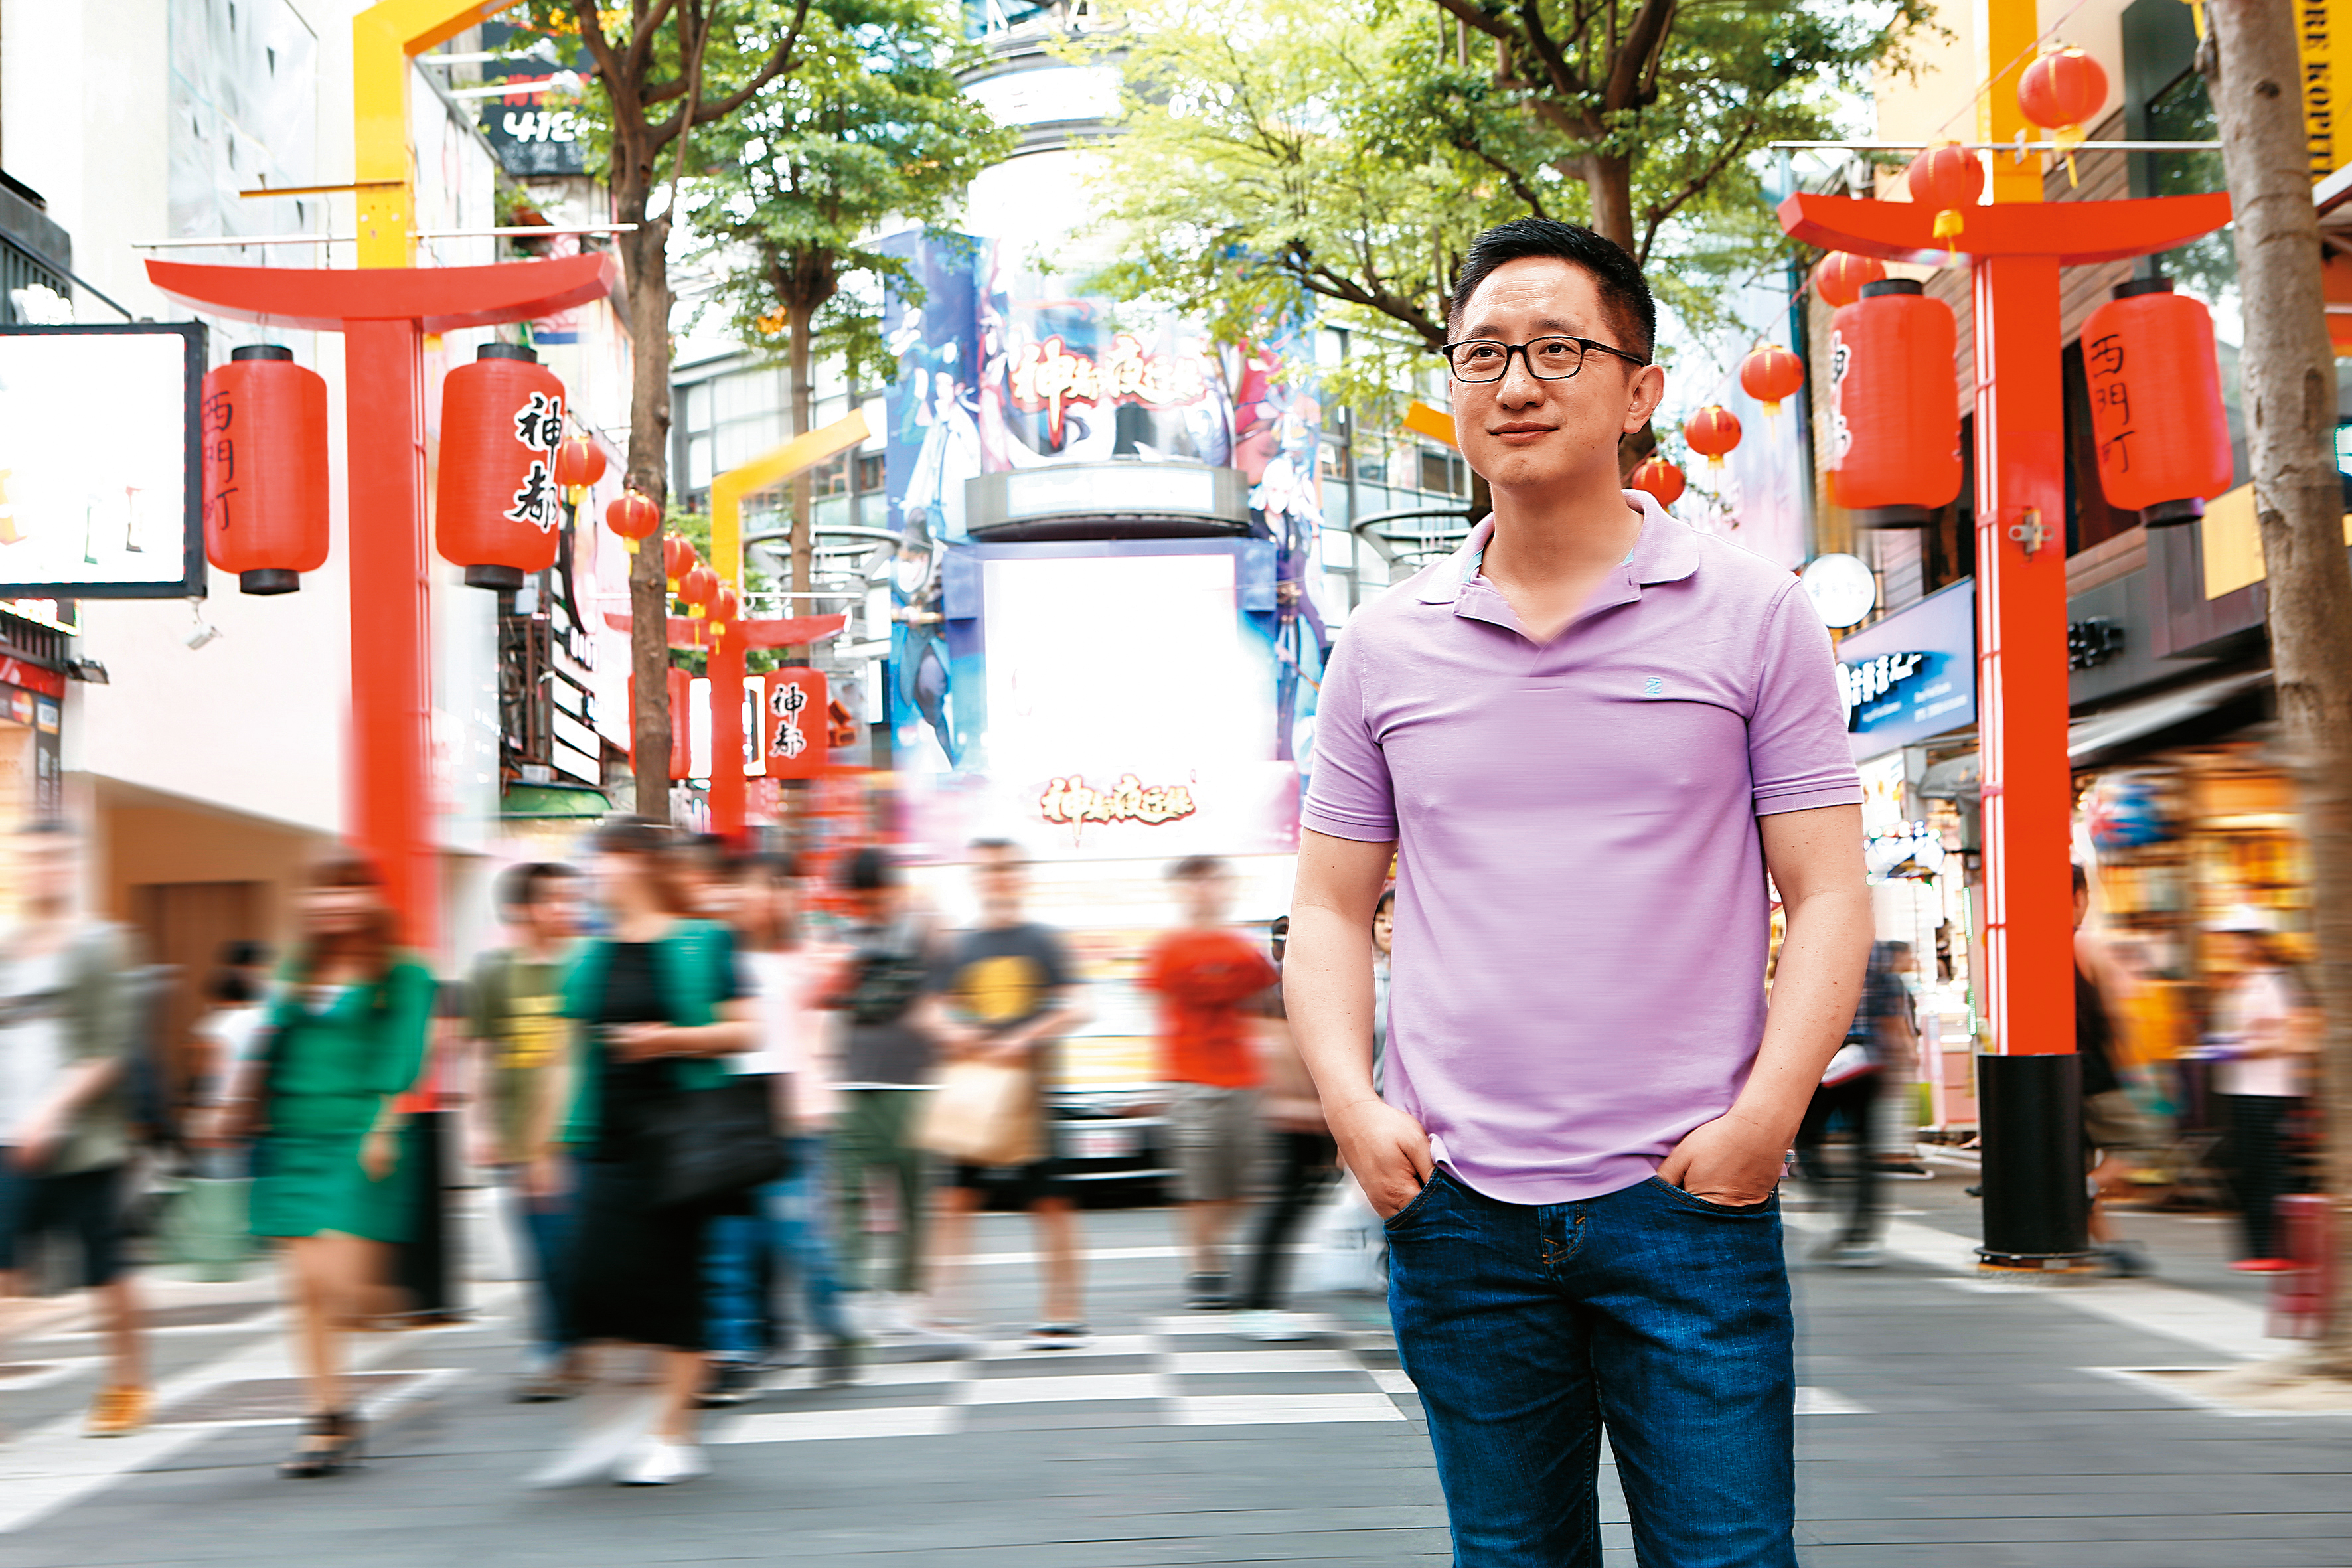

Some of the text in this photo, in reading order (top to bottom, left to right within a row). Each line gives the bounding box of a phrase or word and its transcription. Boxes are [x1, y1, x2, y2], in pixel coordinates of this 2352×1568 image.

[2304, 0, 2329, 50] RE
[507, 394, 564, 531] 神都
[770, 684, 806, 757] 神都
